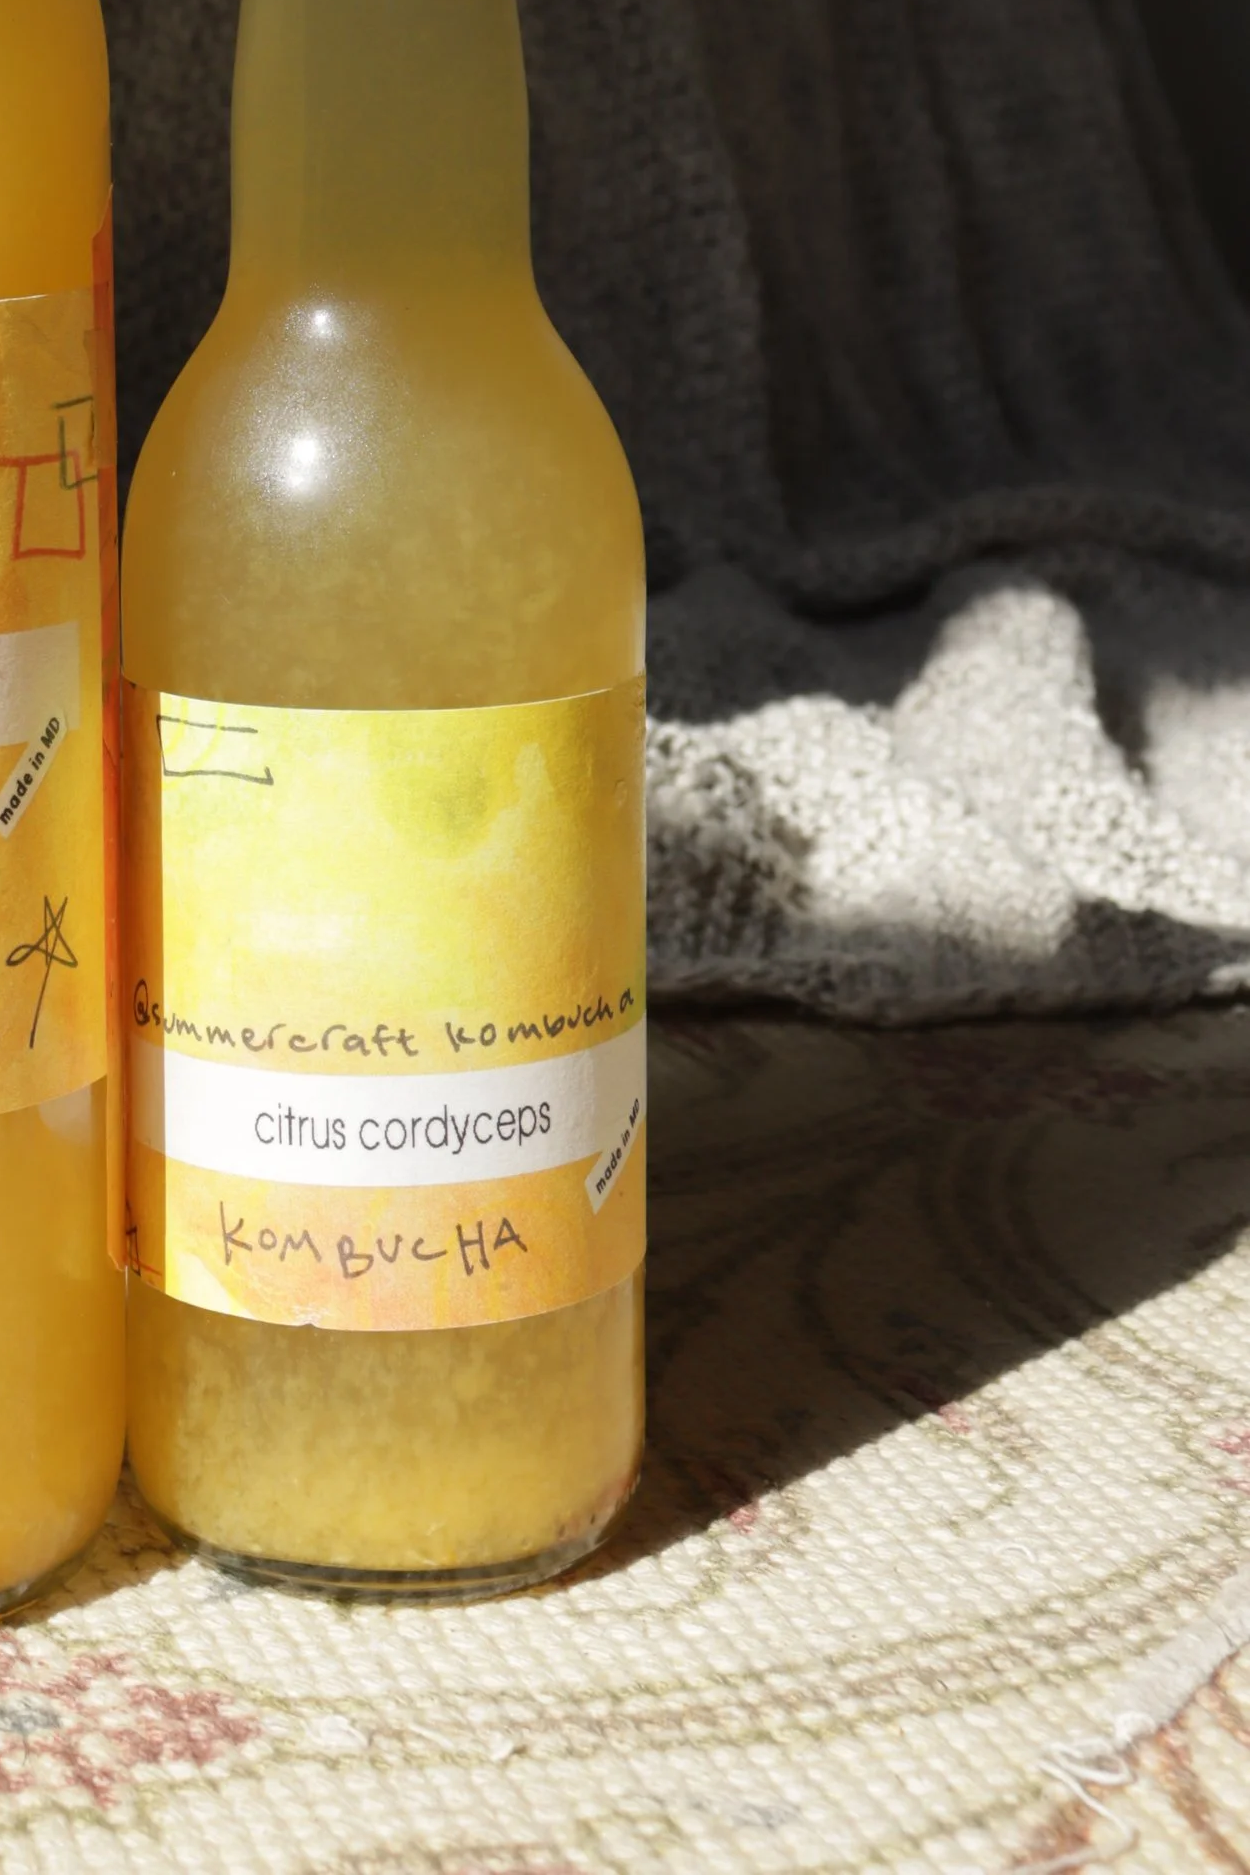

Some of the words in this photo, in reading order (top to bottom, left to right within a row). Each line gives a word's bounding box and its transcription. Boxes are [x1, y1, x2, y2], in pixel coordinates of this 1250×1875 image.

[0, 773, 33, 825] made
[29, 751, 45, 771] in
[40, 717, 60, 749] MD
[133, 979, 420, 1057] @summercraft
[445, 988, 635, 1053] kombucha
[254, 1102, 347, 1150] citrus
[358, 1101, 552, 1155] cordyceps
[595, 1147, 622, 1195] made
[621, 1129, 631, 1147] in
[629, 1098, 640, 1128] MD
[219, 1201, 528, 1280] KOMBUCHA
